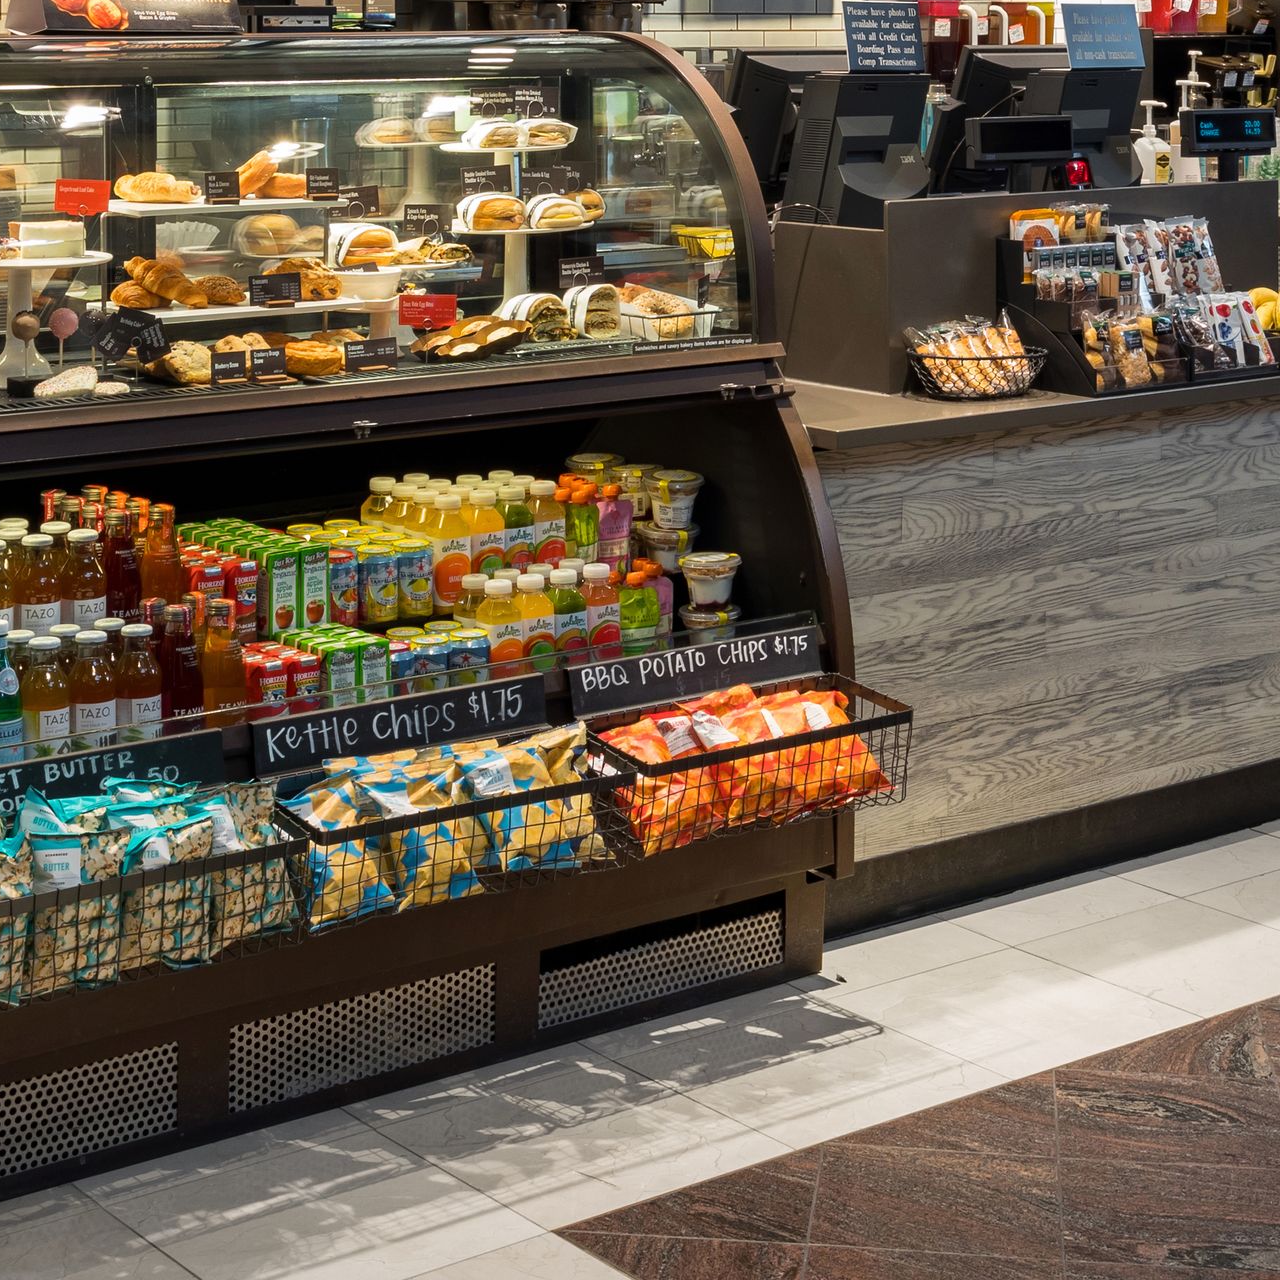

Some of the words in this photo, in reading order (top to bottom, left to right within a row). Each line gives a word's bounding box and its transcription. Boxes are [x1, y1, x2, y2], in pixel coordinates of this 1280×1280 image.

[846, 6, 868, 16] Please
[870, 7, 886, 16] have
[888, 7, 906, 18] photo
[908, 8, 916, 17] ID
[852, 20, 878, 28] available
[880, 20, 890, 28] for
[892, 20, 914, 29] cashier
[852, 32, 866, 40] with
[868, 32, 876, 40] all
[878, 32, 898, 41] Credit
[900, 33, 918, 42] Card,
[856, 44, 884, 55] Boarding
[887, 45, 900, 54] Pass
[904, 46, 914, 54] and
[858, 57, 876, 68] Comp
[878, 57, 916, 66] Transactions
[900, 156, 916, 164] IBM
[24, 608, 56, 619] TAZO
[78, 601, 105, 616] TAZO
[582, 664, 630, 693] BBQ
[639, 648, 706, 685] POTATO
[717, 638, 768, 665] CHIPS
[774, 634, 808, 656] $1.75
[80, 706, 110, 720] TAZO
[268, 716, 358, 763] Kettle
[468, 684, 522, 726] $1.75
[44, 750, 135, 784] BUTTER
[33, 816, 59, 830] BUTTER
[44, 861, 70, 872] BUTTER
